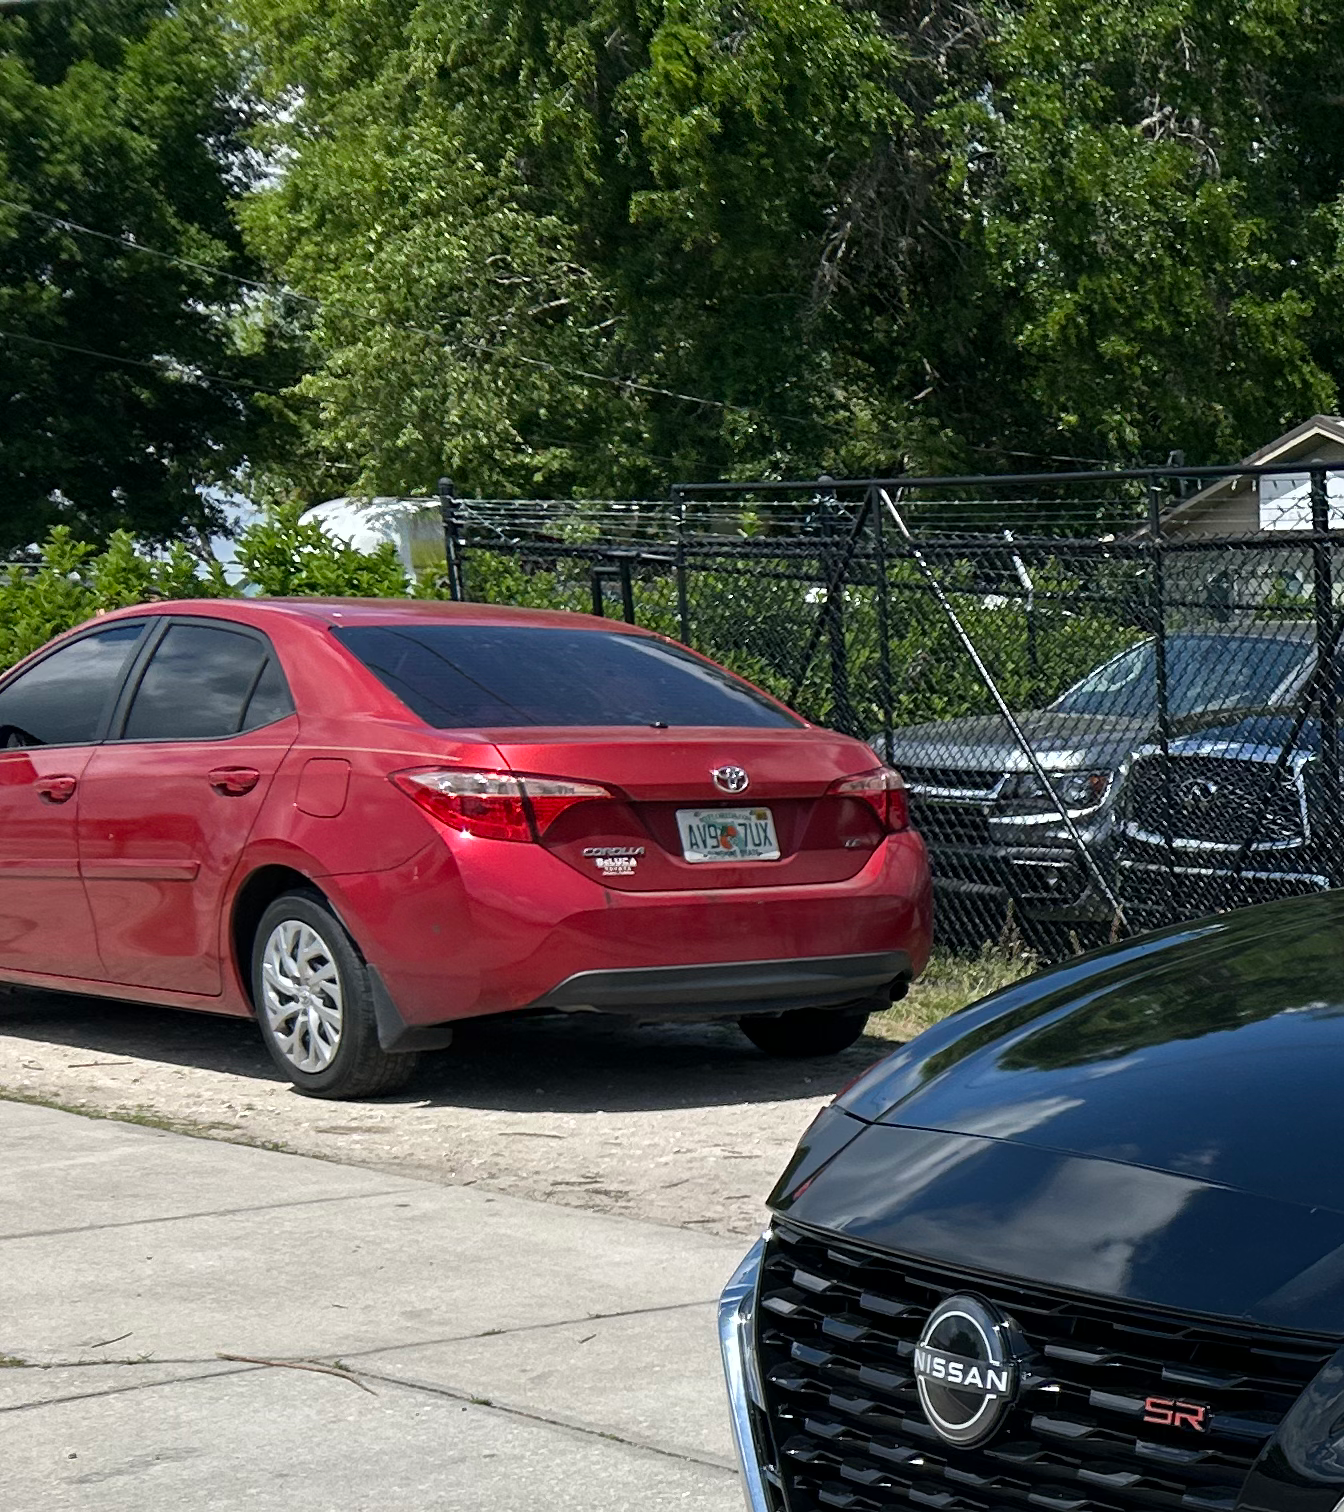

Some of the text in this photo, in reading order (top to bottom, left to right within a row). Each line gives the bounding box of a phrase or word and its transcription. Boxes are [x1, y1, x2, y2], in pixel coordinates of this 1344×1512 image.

[583, 846, 645, 856] COROLLA
[914, 1346, 1009, 1394] NISSAN
[1143, 1395, 1208, 1432] SR
